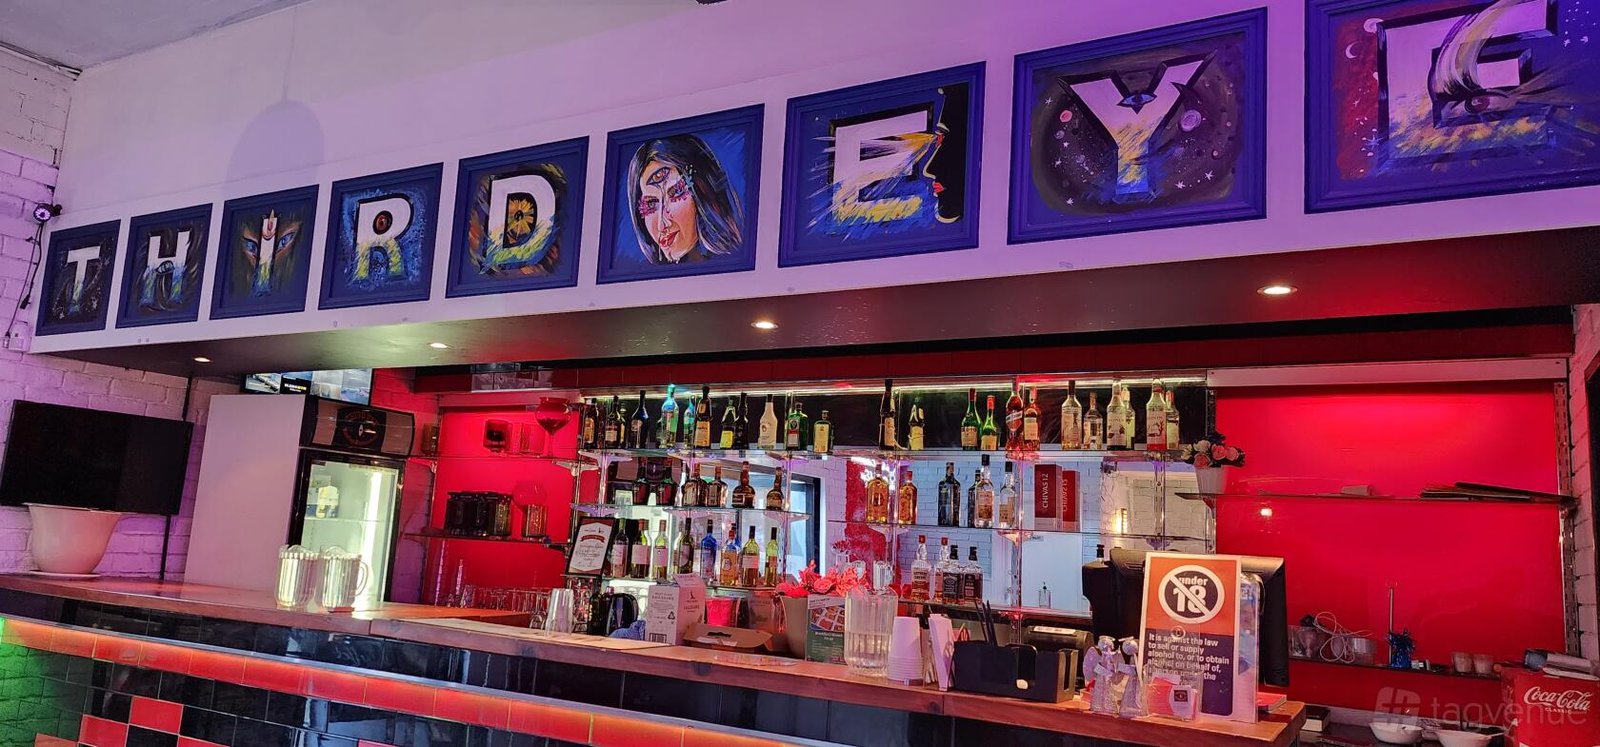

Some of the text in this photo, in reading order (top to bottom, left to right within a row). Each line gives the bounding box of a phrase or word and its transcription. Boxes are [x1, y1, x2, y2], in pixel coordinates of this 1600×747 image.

[1042, 473, 1049, 481] 12
[1178, 576, 1208, 586] under
[1173, 585, 1206, 614] 18
[1148, 633, 1155, 641] It
[1155, 634, 1162, 642] is
[1190, 637, 1203, 646] the
[1204, 638, 1218, 647] law
[1148, 641, 1156, 649] to
[1157, 642, 1169, 650] sell
[1180, 645, 1204, 655] supply
[1147, 650, 1175, 659] alcohol
[1175, 653, 1185, 661] to,
[1196, 654, 1204, 662] to
[1205, 656, 1230, 665] obtain
[1211, 664, 1221, 673] of,
[1203, 672, 1217, 681] the
[1523, 686, 1593, 711] Coca-Cola
[1545, 707, 1571, 715] CLASSIC
